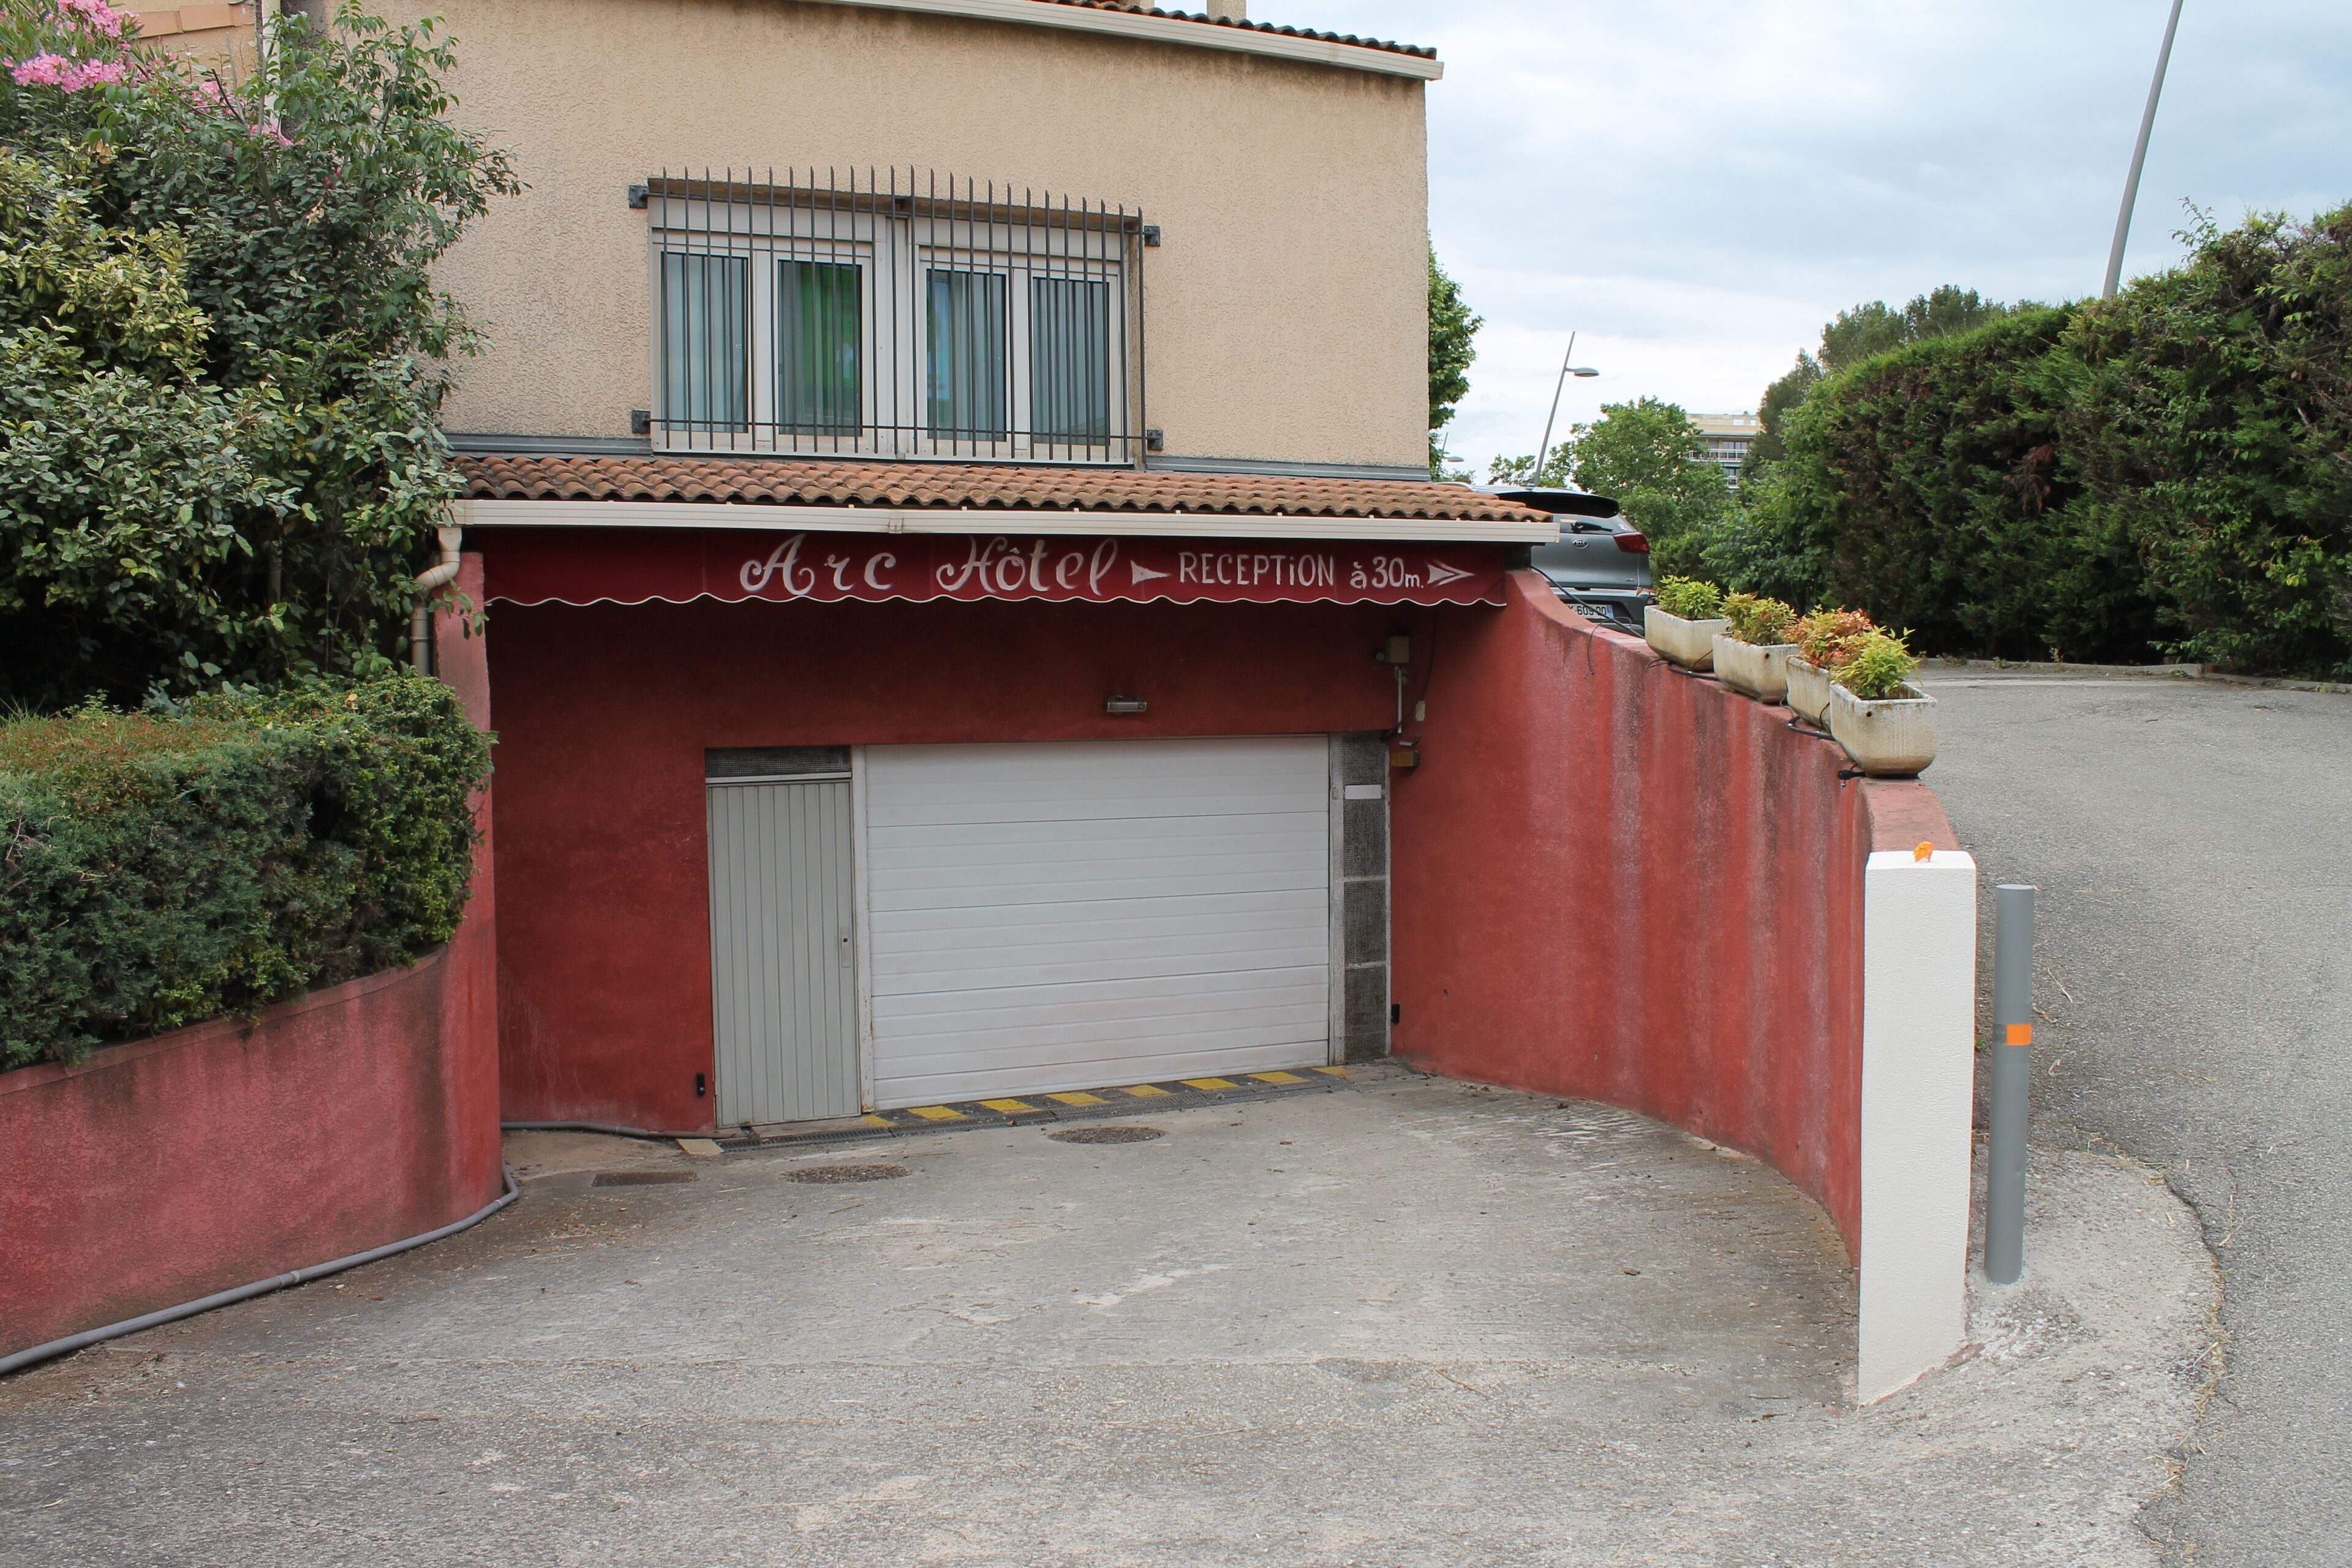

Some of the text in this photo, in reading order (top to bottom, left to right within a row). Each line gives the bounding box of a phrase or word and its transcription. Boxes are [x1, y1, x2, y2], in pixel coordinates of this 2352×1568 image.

[740, 533, 895, 595] Arc
[936, 535, 1117, 596] Hôtel
[1349, 562, 1367, 589] à
